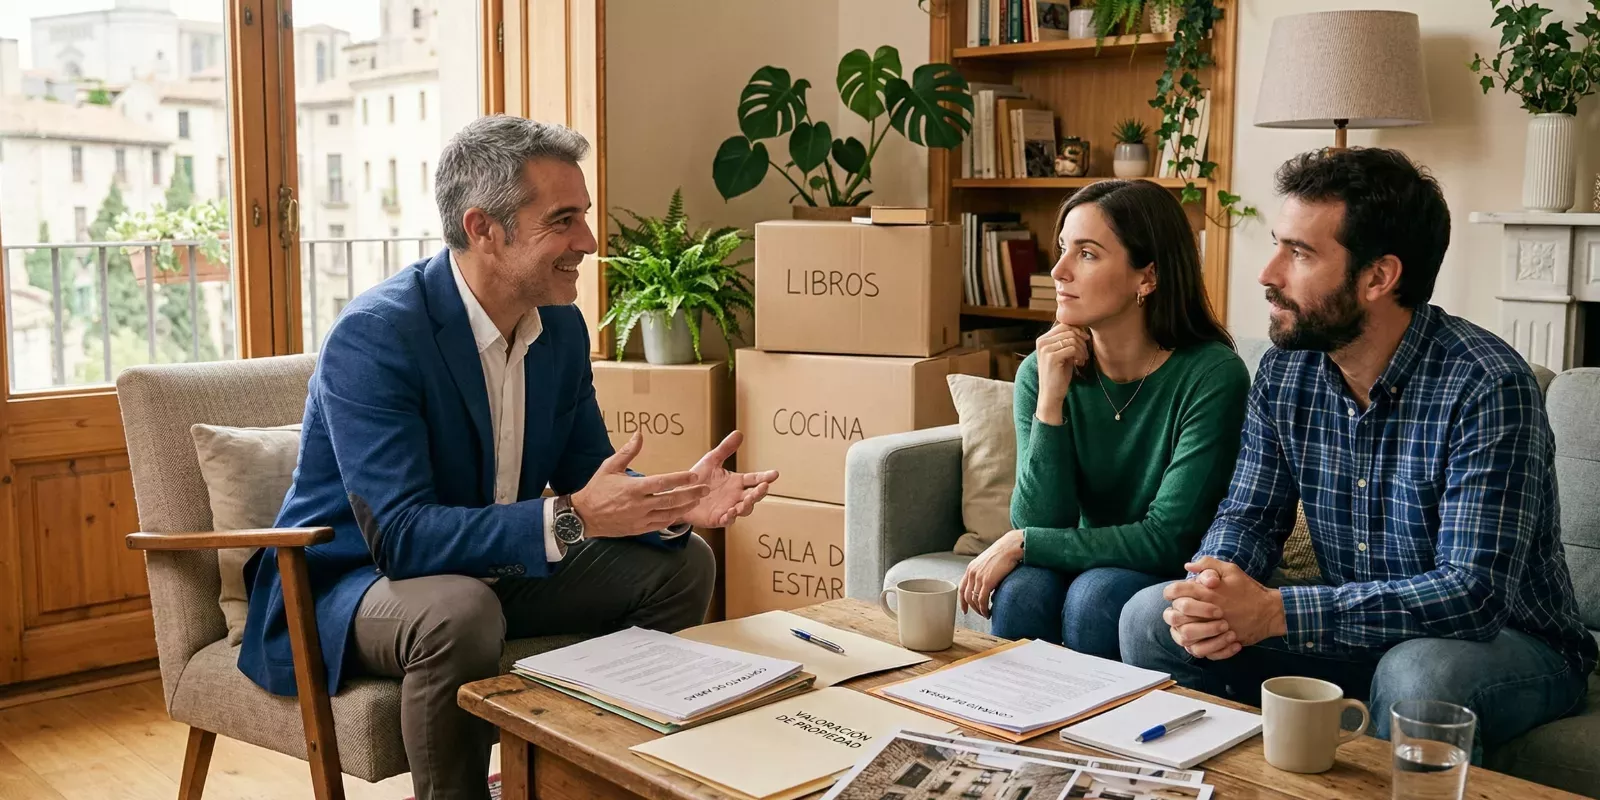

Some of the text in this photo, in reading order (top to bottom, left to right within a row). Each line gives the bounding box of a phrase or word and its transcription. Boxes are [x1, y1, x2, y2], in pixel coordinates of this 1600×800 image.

[787, 268, 880, 298] LIBROS
[757, 533, 845, 567] SALA D
[772, 570, 844, 600] ESTAR
[775, 714, 863, 749] DE PROPIEDAD
[795, 710, 873, 742] VALORACIÓN
